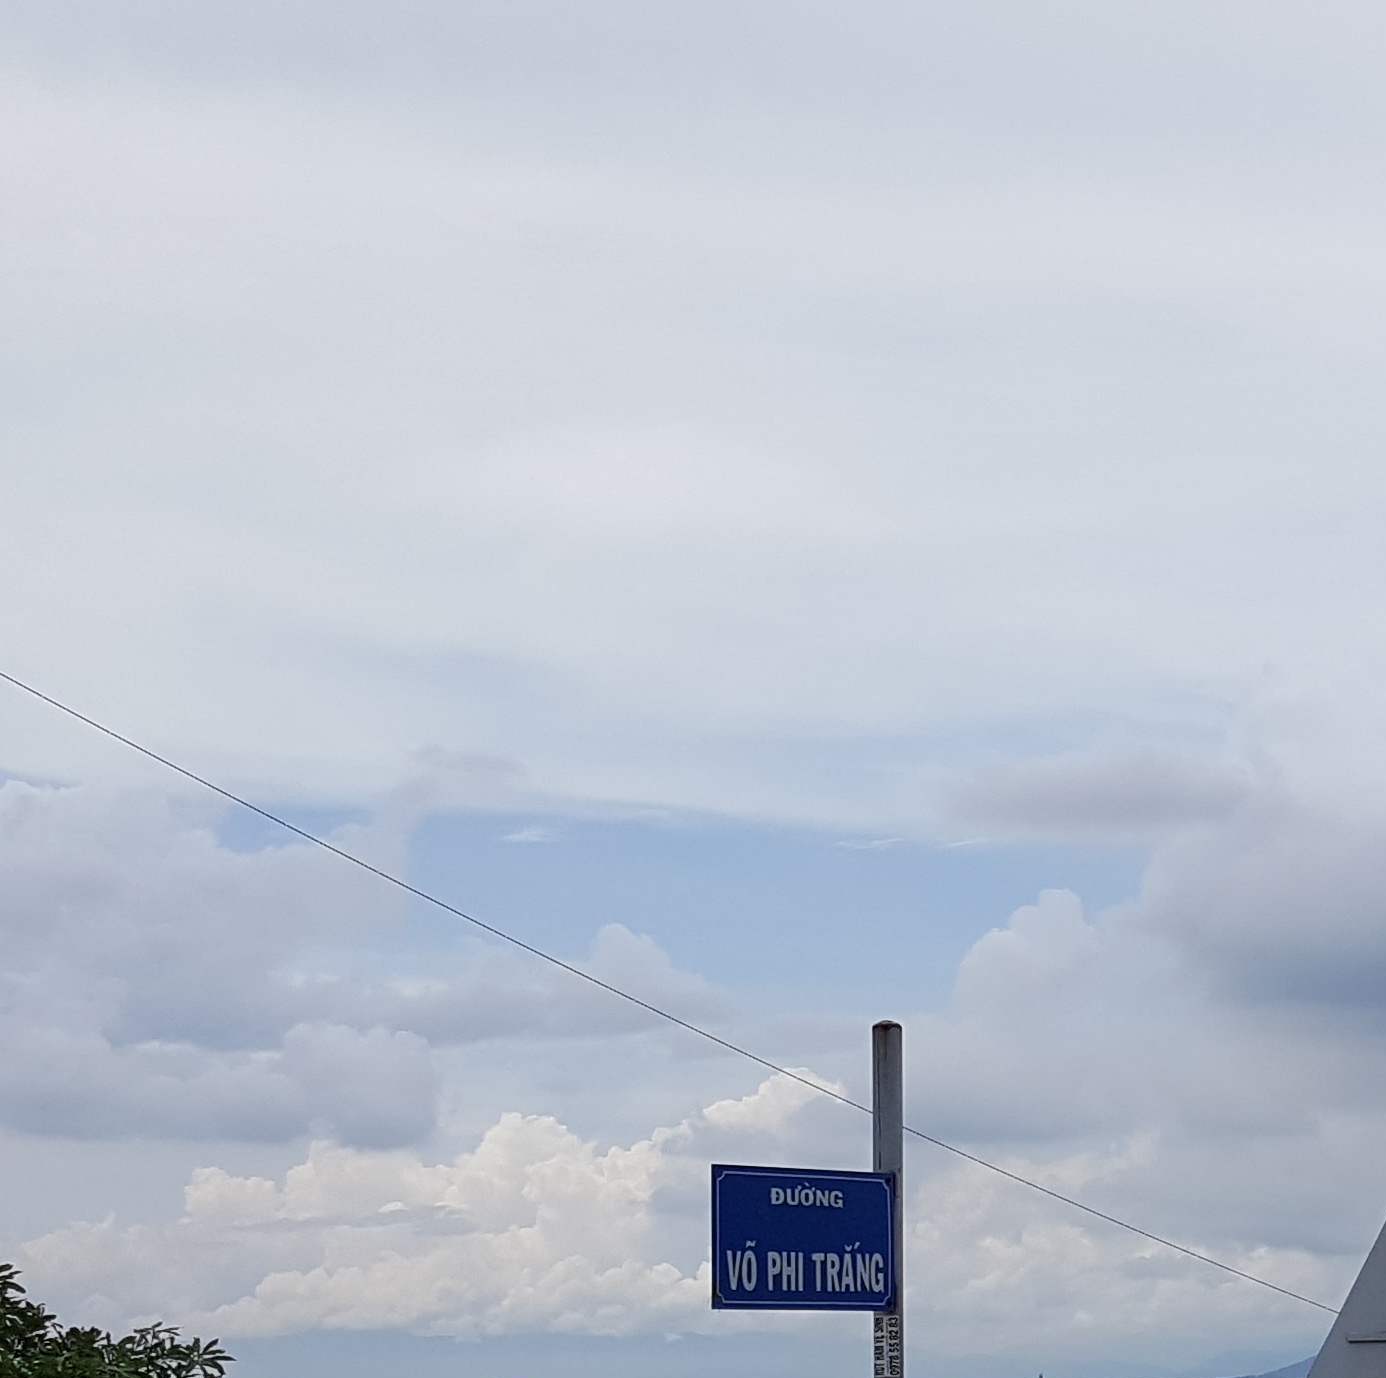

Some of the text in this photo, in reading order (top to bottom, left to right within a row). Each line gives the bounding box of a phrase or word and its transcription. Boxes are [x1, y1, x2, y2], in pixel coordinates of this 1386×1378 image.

[770, 1182, 844, 1208] ĐƯỜNG
[726, 1240, 885, 1293] VÕ PHI TRẮNG
